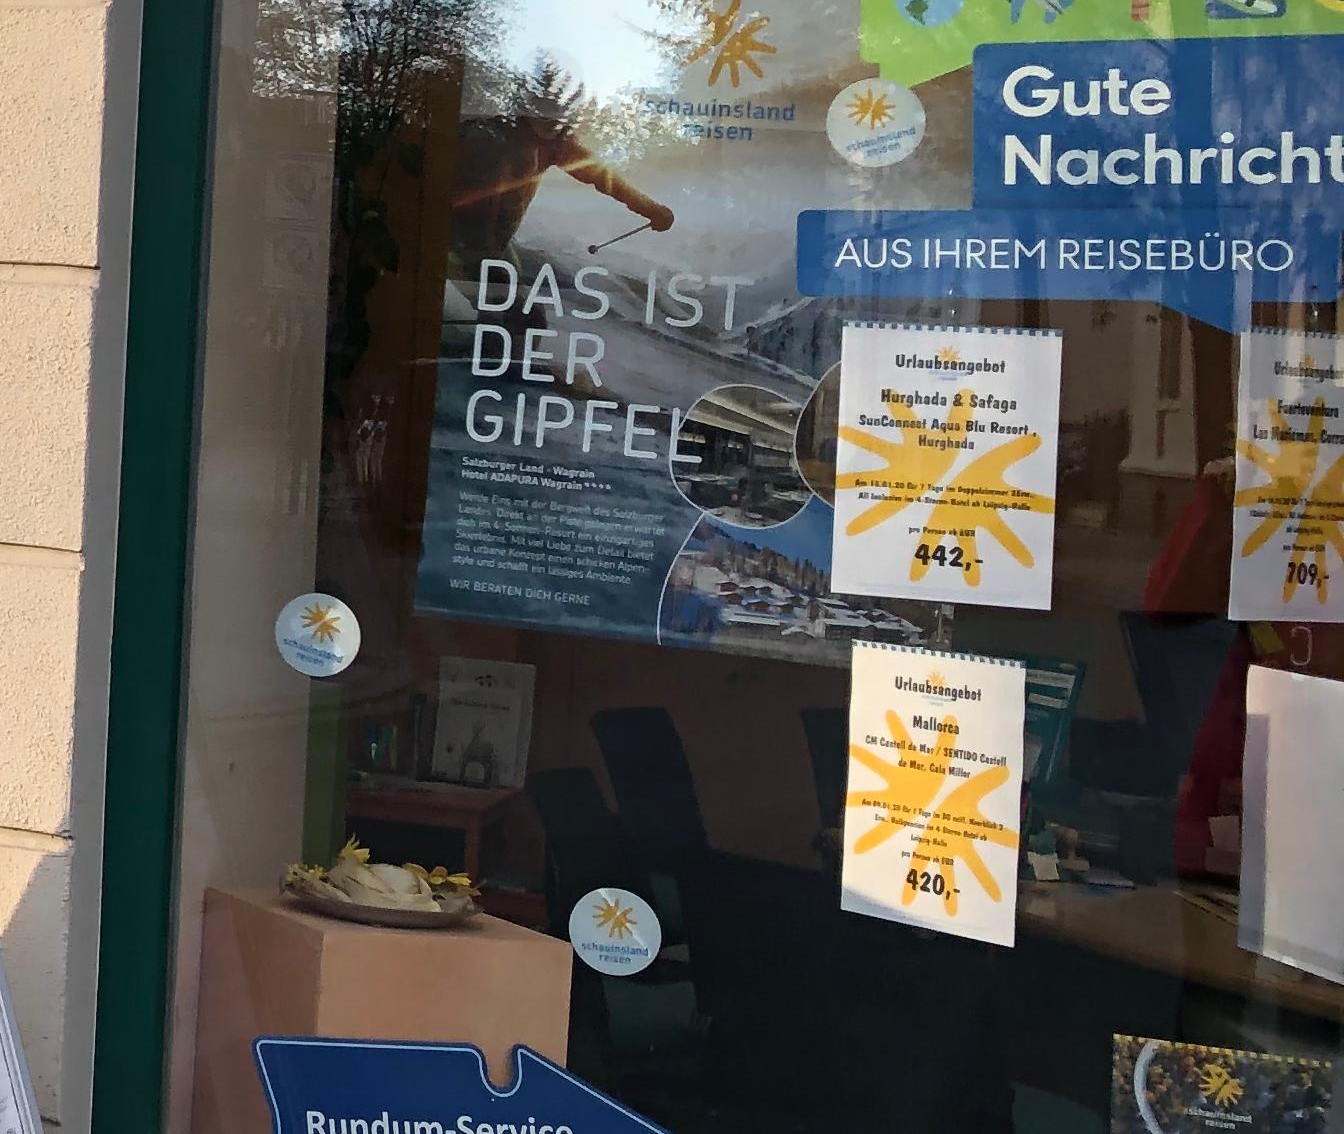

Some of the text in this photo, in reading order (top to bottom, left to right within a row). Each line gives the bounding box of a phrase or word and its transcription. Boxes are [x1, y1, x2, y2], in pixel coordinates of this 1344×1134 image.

[1003, 64, 1172, 118] Gute
[646, 98, 795, 121] schauinsland
[834, 231, 1294, 272] AUS IHREM REISEBÜRO
[478, 258, 754, 331] DAS IST
[471, 323, 605, 387] DER
[895, 354, 1006, 375] Urlaubsangebot
[881, 388, 1017, 413] Hurghada & Safaga
[465, 389, 703, 464] GIPFEL
[931, 418, 960, 434] Aqua
[965, 419, 985, 433] Blu
[990, 421, 1028, 435] Resort
[919, 437, 975, 451] Hurghada
[461, 469, 583, 491] Hotel ADAPURA Wagrain
[462, 456, 595, 480] Salzburger Land Wagrain
[958, 486, 1009, 498] Doppelzimmer
[914, 543, 983, 572] 442,-
[449, 579, 591, 606] WIR BERATEN DICH GERNE
[895, 676, 981, 702] Urlaubsangebot
[912, 714, 960, 735] Mallorca
[865, 734, 877, 745] CM
[943, 746, 978, 763] SENTIDO
[929, 762, 946, 775] Cala
[906, 869, 960, 900] 420,-
[581, 941, 649, 958] schauinsland
[598, 952, 631, 965] reisen
